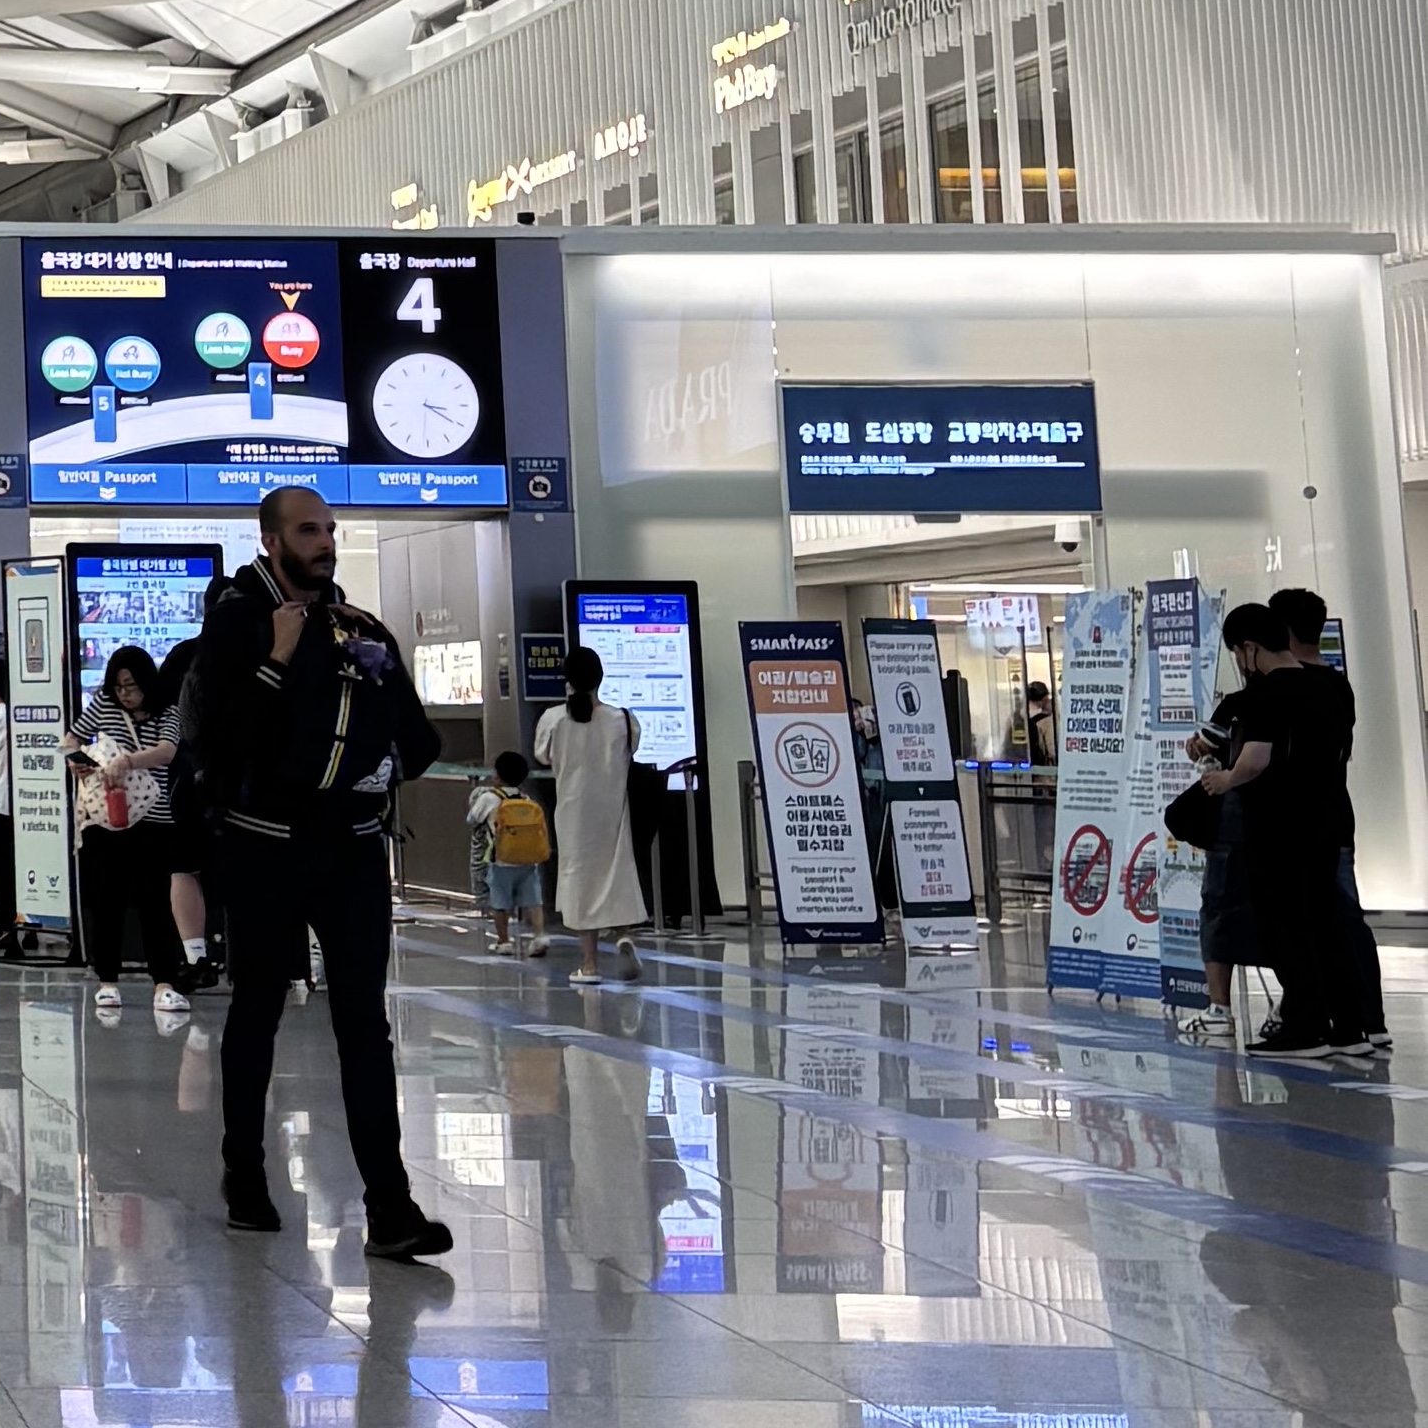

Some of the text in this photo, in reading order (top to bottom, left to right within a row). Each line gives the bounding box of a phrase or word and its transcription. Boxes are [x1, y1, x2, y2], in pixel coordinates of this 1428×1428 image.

[84, 252, 113, 269] 대기
[144, 252, 173, 270] 안내
[359, 252, 401, 270] 출국장
[407, 256, 476, 269] Departure Hall
[396, 277, 442, 333] 4
[280, 345, 304, 358] Busy
[254, 372, 266, 387] 4
[98, 396, 109, 411] 5
[105, 471, 157, 485] Passport
[265, 472, 317, 486] Passport
[425, 472, 478, 486] Passport
[750, 634, 834, 650] SMARTPASS
[869, 641, 895, 650] Please
[785, 794, 845, 807] 스마트패스
[791, 865, 856, 874] Please carry your
[805, 876, 837, 884] passport
[800, 886, 853, 894] boarding pass
